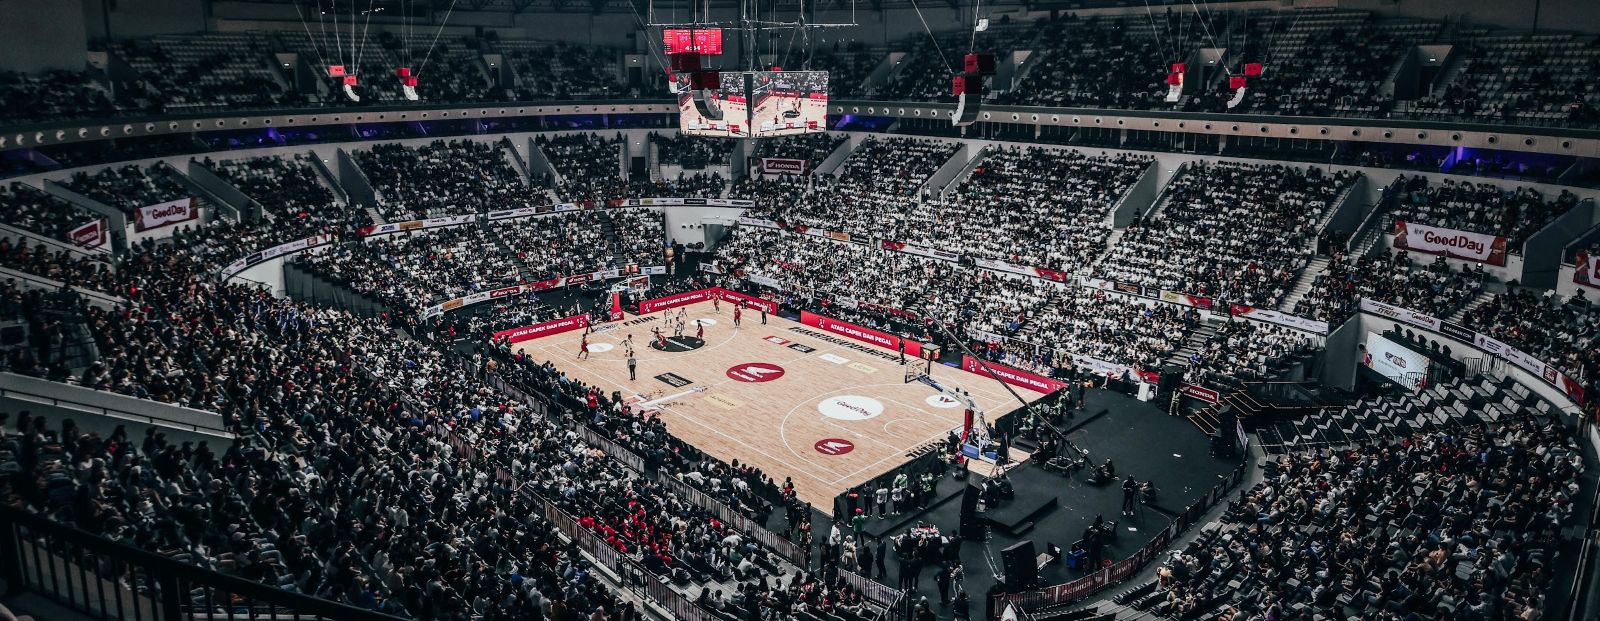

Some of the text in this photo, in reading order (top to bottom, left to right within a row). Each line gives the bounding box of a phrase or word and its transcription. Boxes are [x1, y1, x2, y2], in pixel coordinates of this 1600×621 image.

[512, 320, 575, 338] ATASI CAPEK DAN PEGAL
[830, 323, 845, 332] ATASI
[845, 327, 863, 337] CAPEK
[862, 332, 875, 340] DAN
[874, 336, 893, 345] PEGAL
[997, 370, 1016, 380] CAPEK
[1016, 375, 1029, 384] DAN
[1029, 379, 1049, 390] PEGAL
[1188, 387, 1215, 400] HONDA
